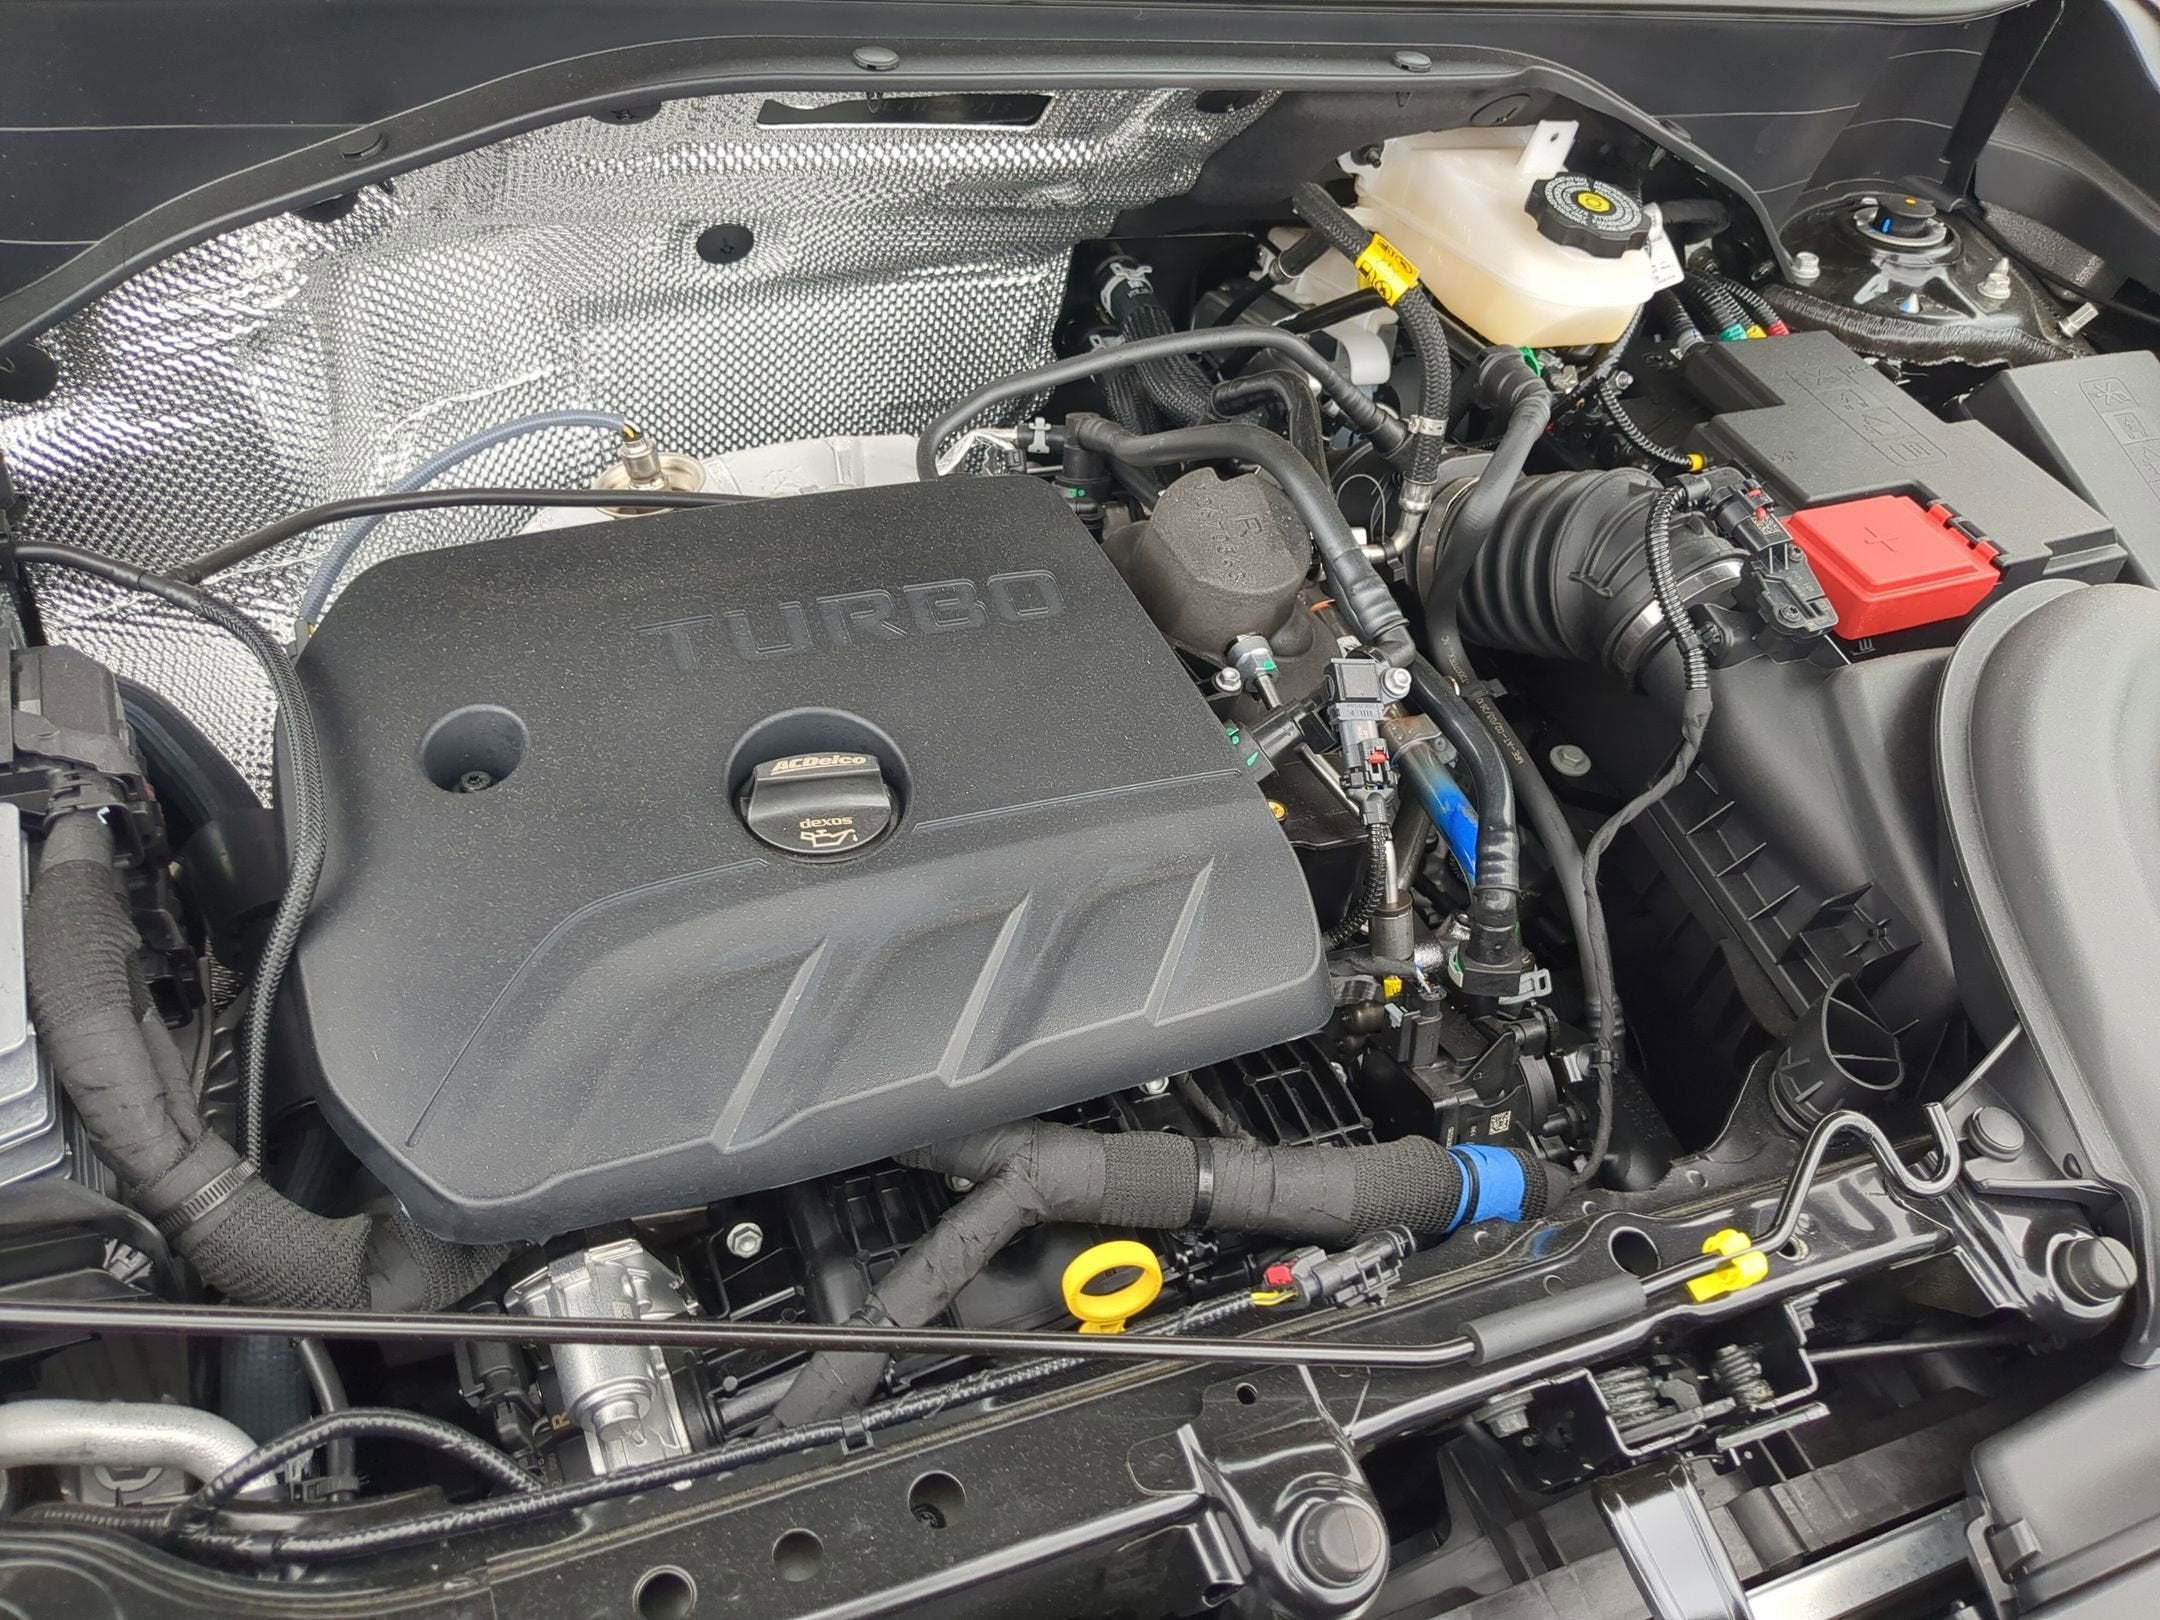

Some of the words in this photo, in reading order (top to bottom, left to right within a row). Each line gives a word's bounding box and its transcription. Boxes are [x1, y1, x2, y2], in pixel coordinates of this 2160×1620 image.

[634, 569, 1067, 673] TURBO
[771, 755, 867, 774] ACDelco
[800, 816, 854, 829] dexos
